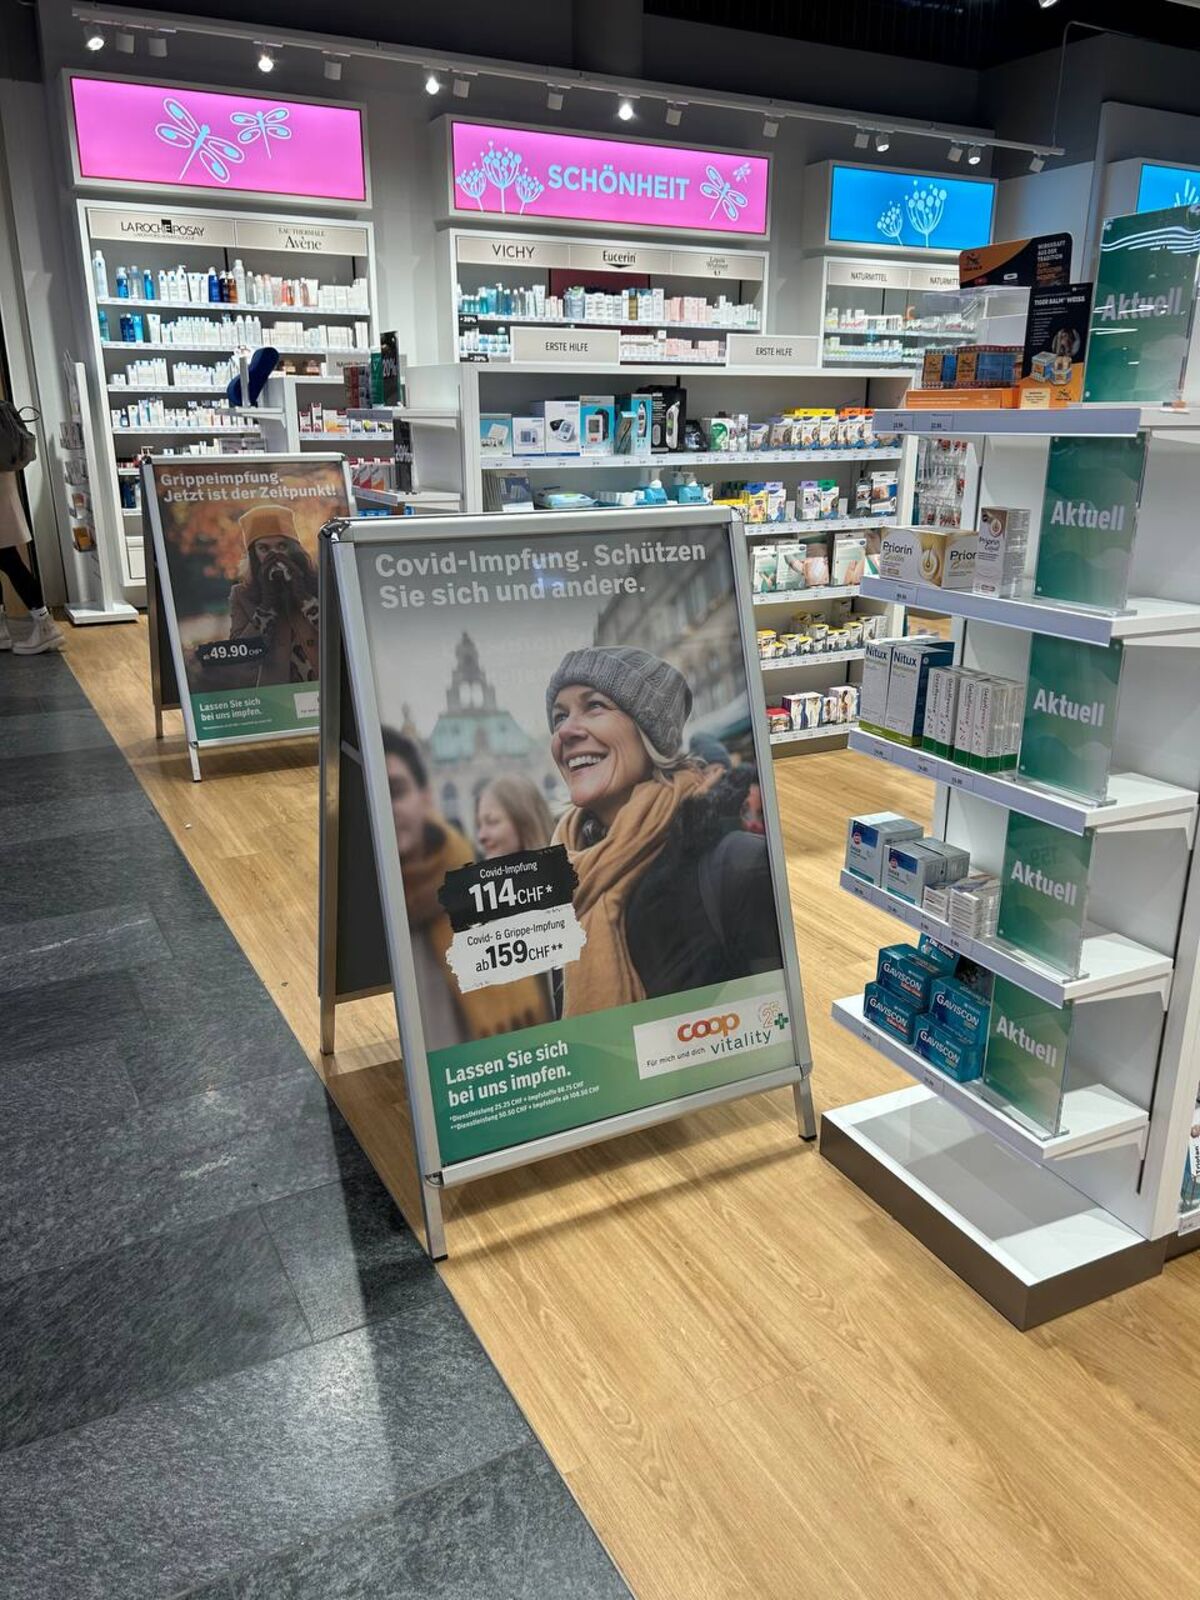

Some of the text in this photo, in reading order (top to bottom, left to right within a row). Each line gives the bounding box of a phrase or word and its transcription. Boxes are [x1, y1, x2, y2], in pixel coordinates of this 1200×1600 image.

[547, 164, 690, 201] SCHÖNHEIT
[285, 235, 322, 250] Avène
[492, 244, 535, 259] VICHY
[602, 249, 636, 263] Eucerin
[929, 276, 960, 286] NATURMITT
[1101, 287, 1183, 321] Aktuell
[545, 341, 588, 352] ERSTE HILFE
[755, 346, 793, 357] ERSTE HILFE
[161, 471, 284, 488] Grippeimpfung.
[164, 484, 337, 502] Jetzt ist der Zeitpunkt!
[1050, 501, 1125, 531] Aktuell
[375, 542, 706, 577] Covid-Impfung. Schützen
[883, 541, 912, 555] Priorin
[950, 550, 977, 561] Prior
[379, 574, 645, 609] Sie sich und andere.
[210, 644, 248, 659] 49.90
[865, 645, 887, 660] Nitux
[894, 651, 917, 667] Nitux
[200, 697, 261, 712] Lassen Sie sich
[201, 708, 262, 721] bei uns impfen.
[1033, 688, 1105, 727] Aktuell
[480, 861, 538, 879] Covid-Impfung
[1011, 859, 1077, 906] Aktuell
[467, 918, 566, 946] Covid- & Grippe-Impfung
[883, 963, 922, 991] GAVISCON
[869, 998, 908, 1027] GAVISCON
[936, 994, 980, 1026] GAVISCON
[677, 1012, 741, 1042] coop
[646, 1029, 772, 1067] Für mich und dich vitality
[920, 1030, 960, 1064] GAVISCON
[996, 1015, 1057, 1068] Aktuell
[445, 1039, 569, 1085] Lassen Sie sich
[448, 1063, 572, 1108] bei uns impfen.
